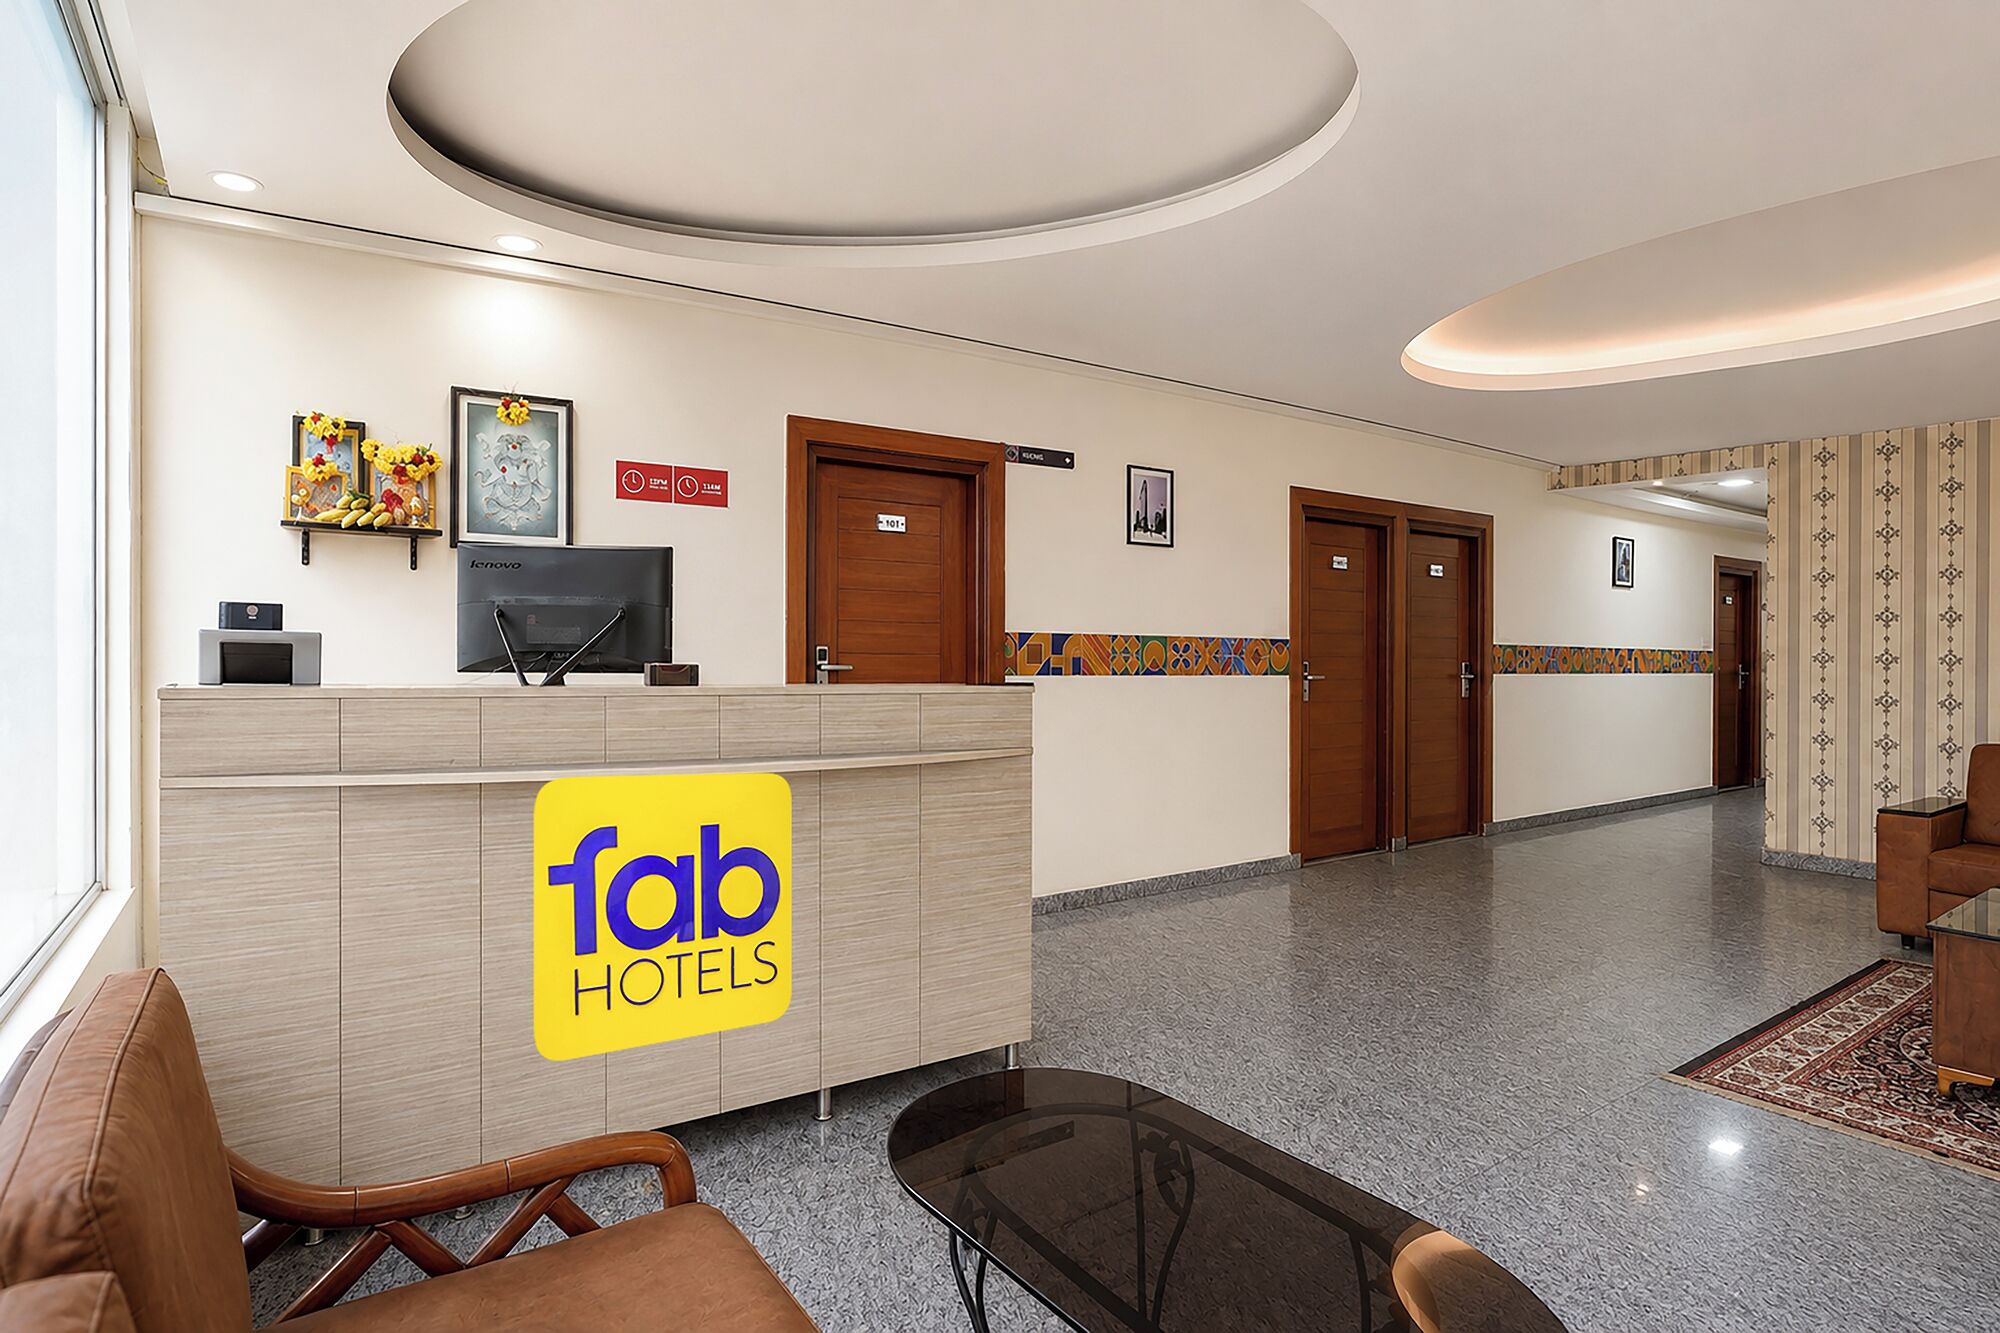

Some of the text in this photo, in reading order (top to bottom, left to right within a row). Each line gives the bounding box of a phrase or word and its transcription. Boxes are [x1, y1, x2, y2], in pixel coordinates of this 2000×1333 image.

[886, 520, 899, 528] 101
[470, 559, 521, 570] lenovo
[548, 824, 781, 956] fab
[574, 941, 778, 1016] HOTELS
